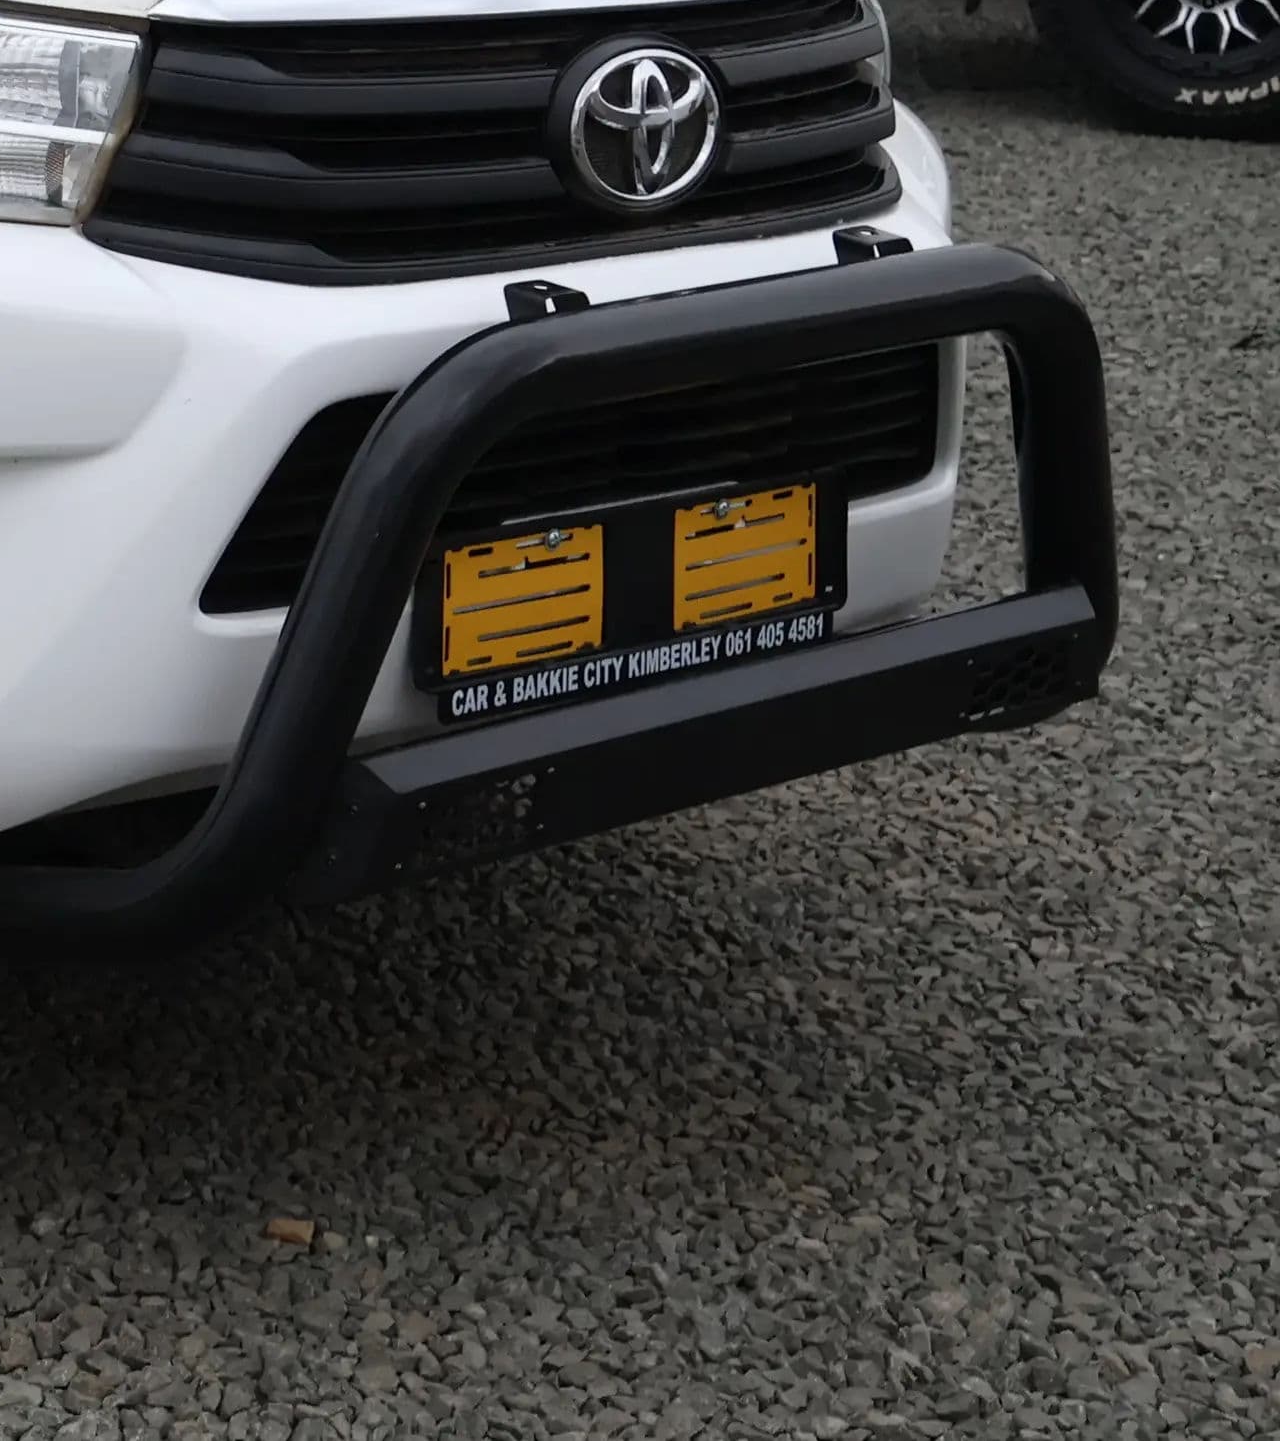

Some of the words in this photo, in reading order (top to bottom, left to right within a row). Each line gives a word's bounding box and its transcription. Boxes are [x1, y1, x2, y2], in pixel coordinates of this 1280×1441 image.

[452, 684, 489, 716] CAR
[494, 680, 508, 707] &
[512, 665, 580, 704] BAKKIE
[583, 655, 624, 689] CITY
[628, 634, 722, 679] KIMBERLEY
[725, 627, 752, 657] 061
[756, 621, 785, 651] 405
[787, 612, 825, 644] 4581
